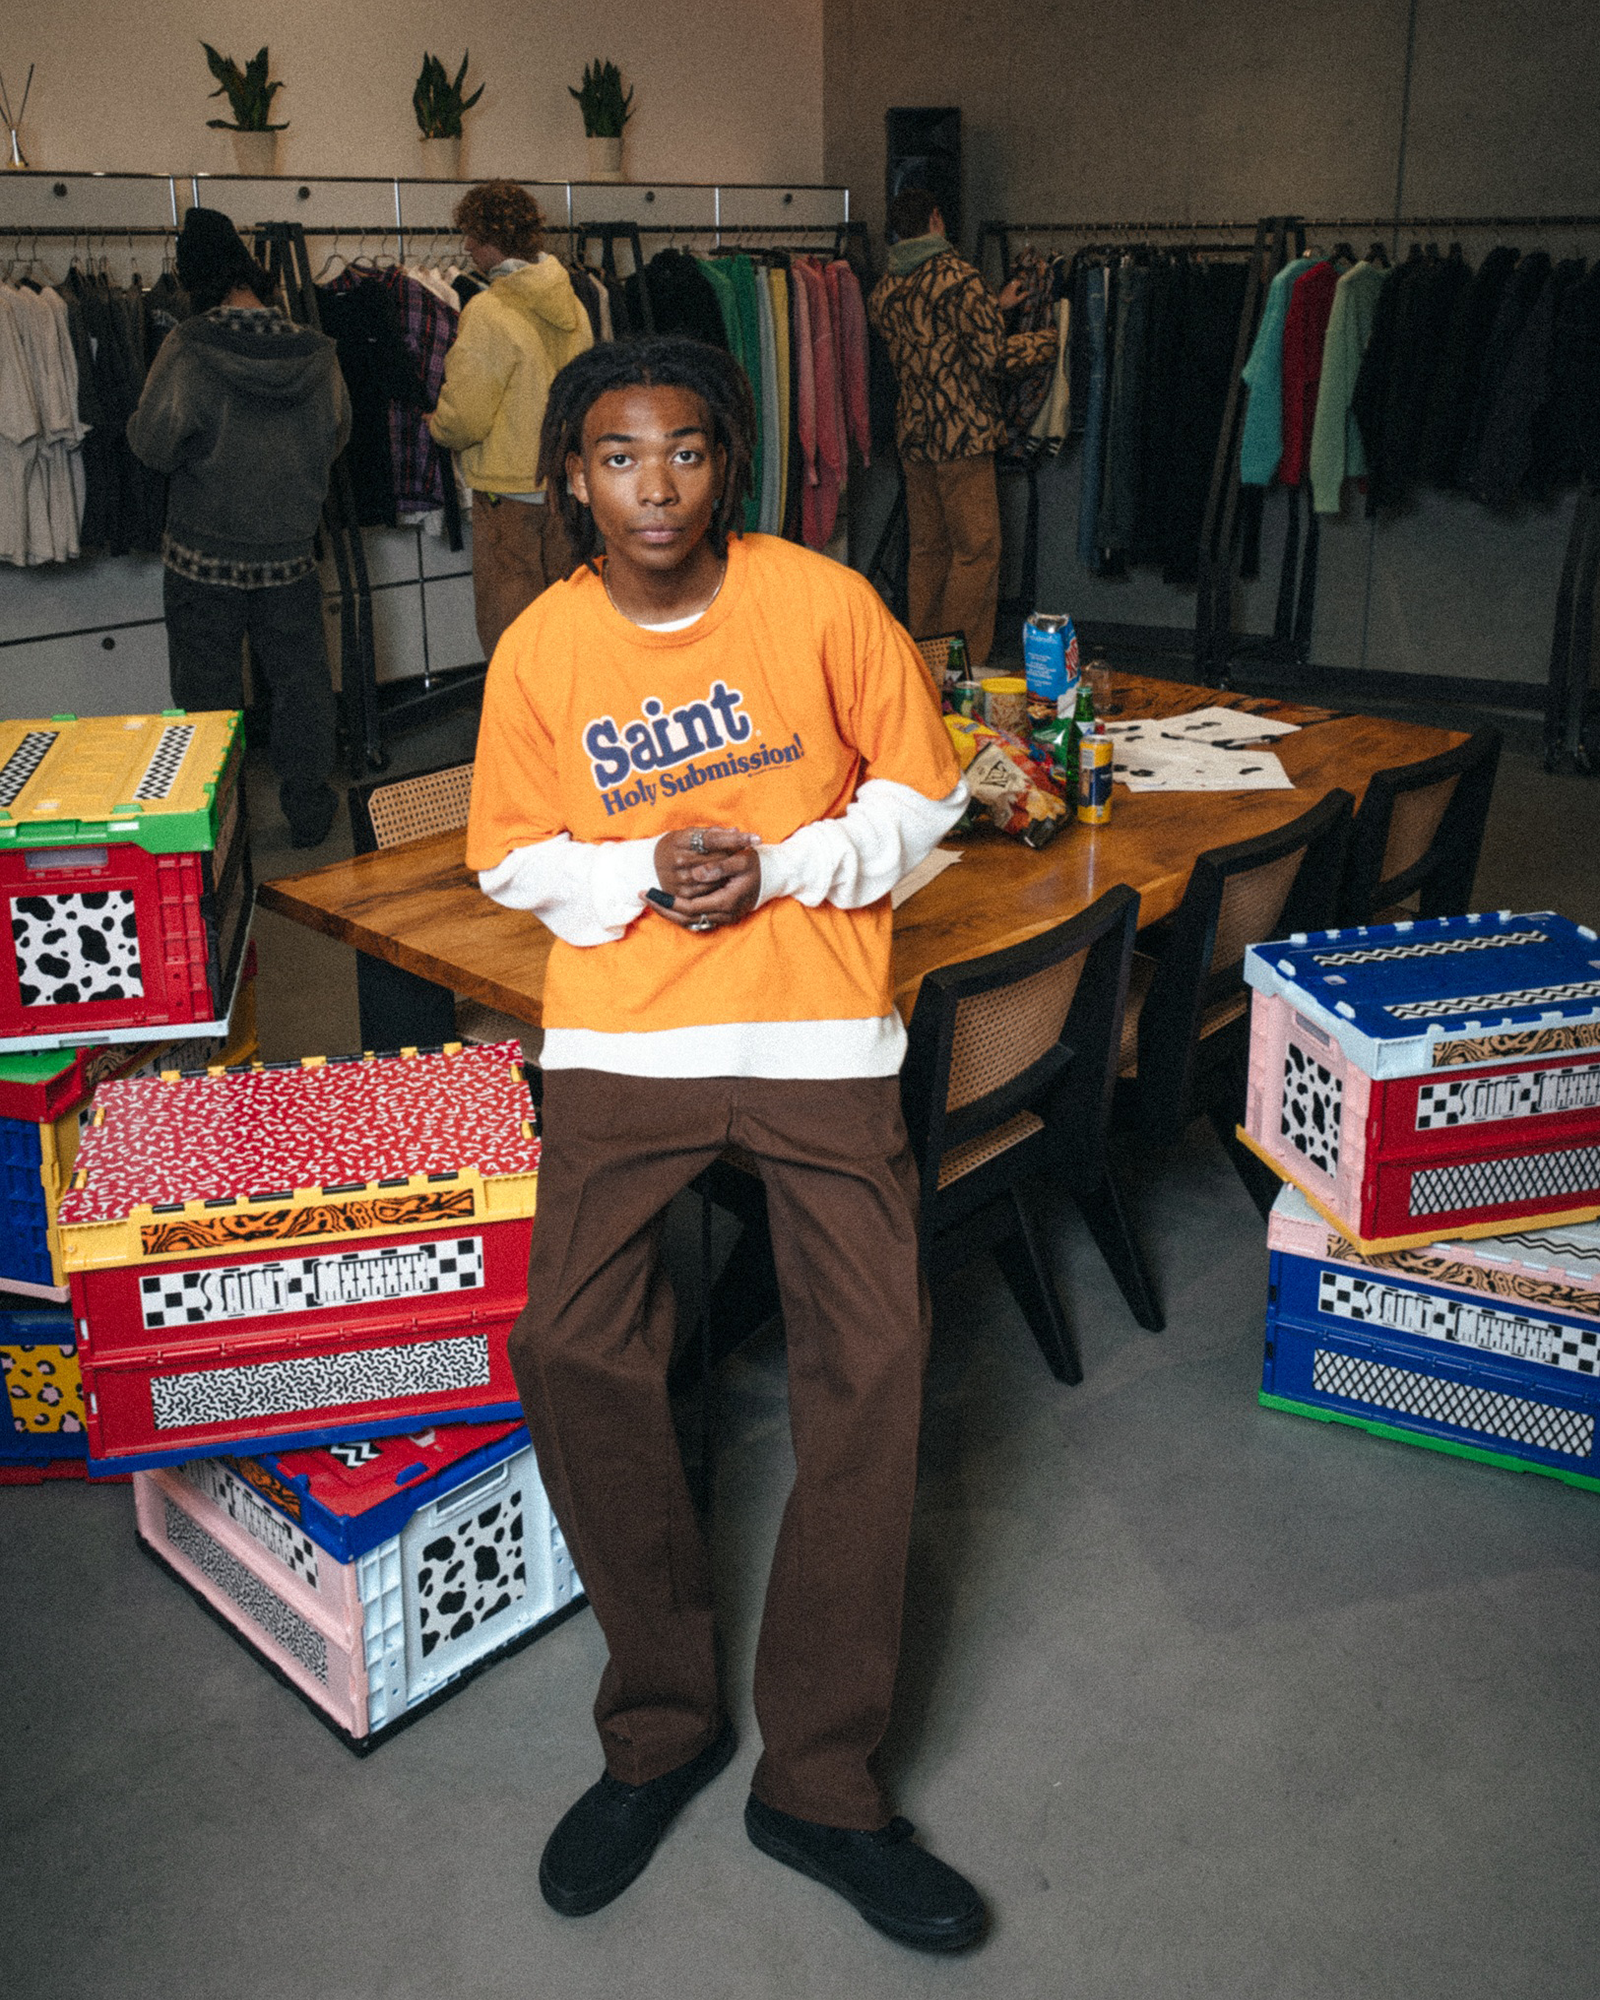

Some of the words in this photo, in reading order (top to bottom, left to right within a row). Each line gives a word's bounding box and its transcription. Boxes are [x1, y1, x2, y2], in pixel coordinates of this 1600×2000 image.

[582, 680, 752, 789] Saint
[601, 779, 656, 816] Holy
[659, 732, 804, 797] Submission!
[1460, 1078, 1522, 1120] SAINT
[200, 1267, 289, 1319] SAINT
[1363, 1283, 1435, 1333] SAINT
